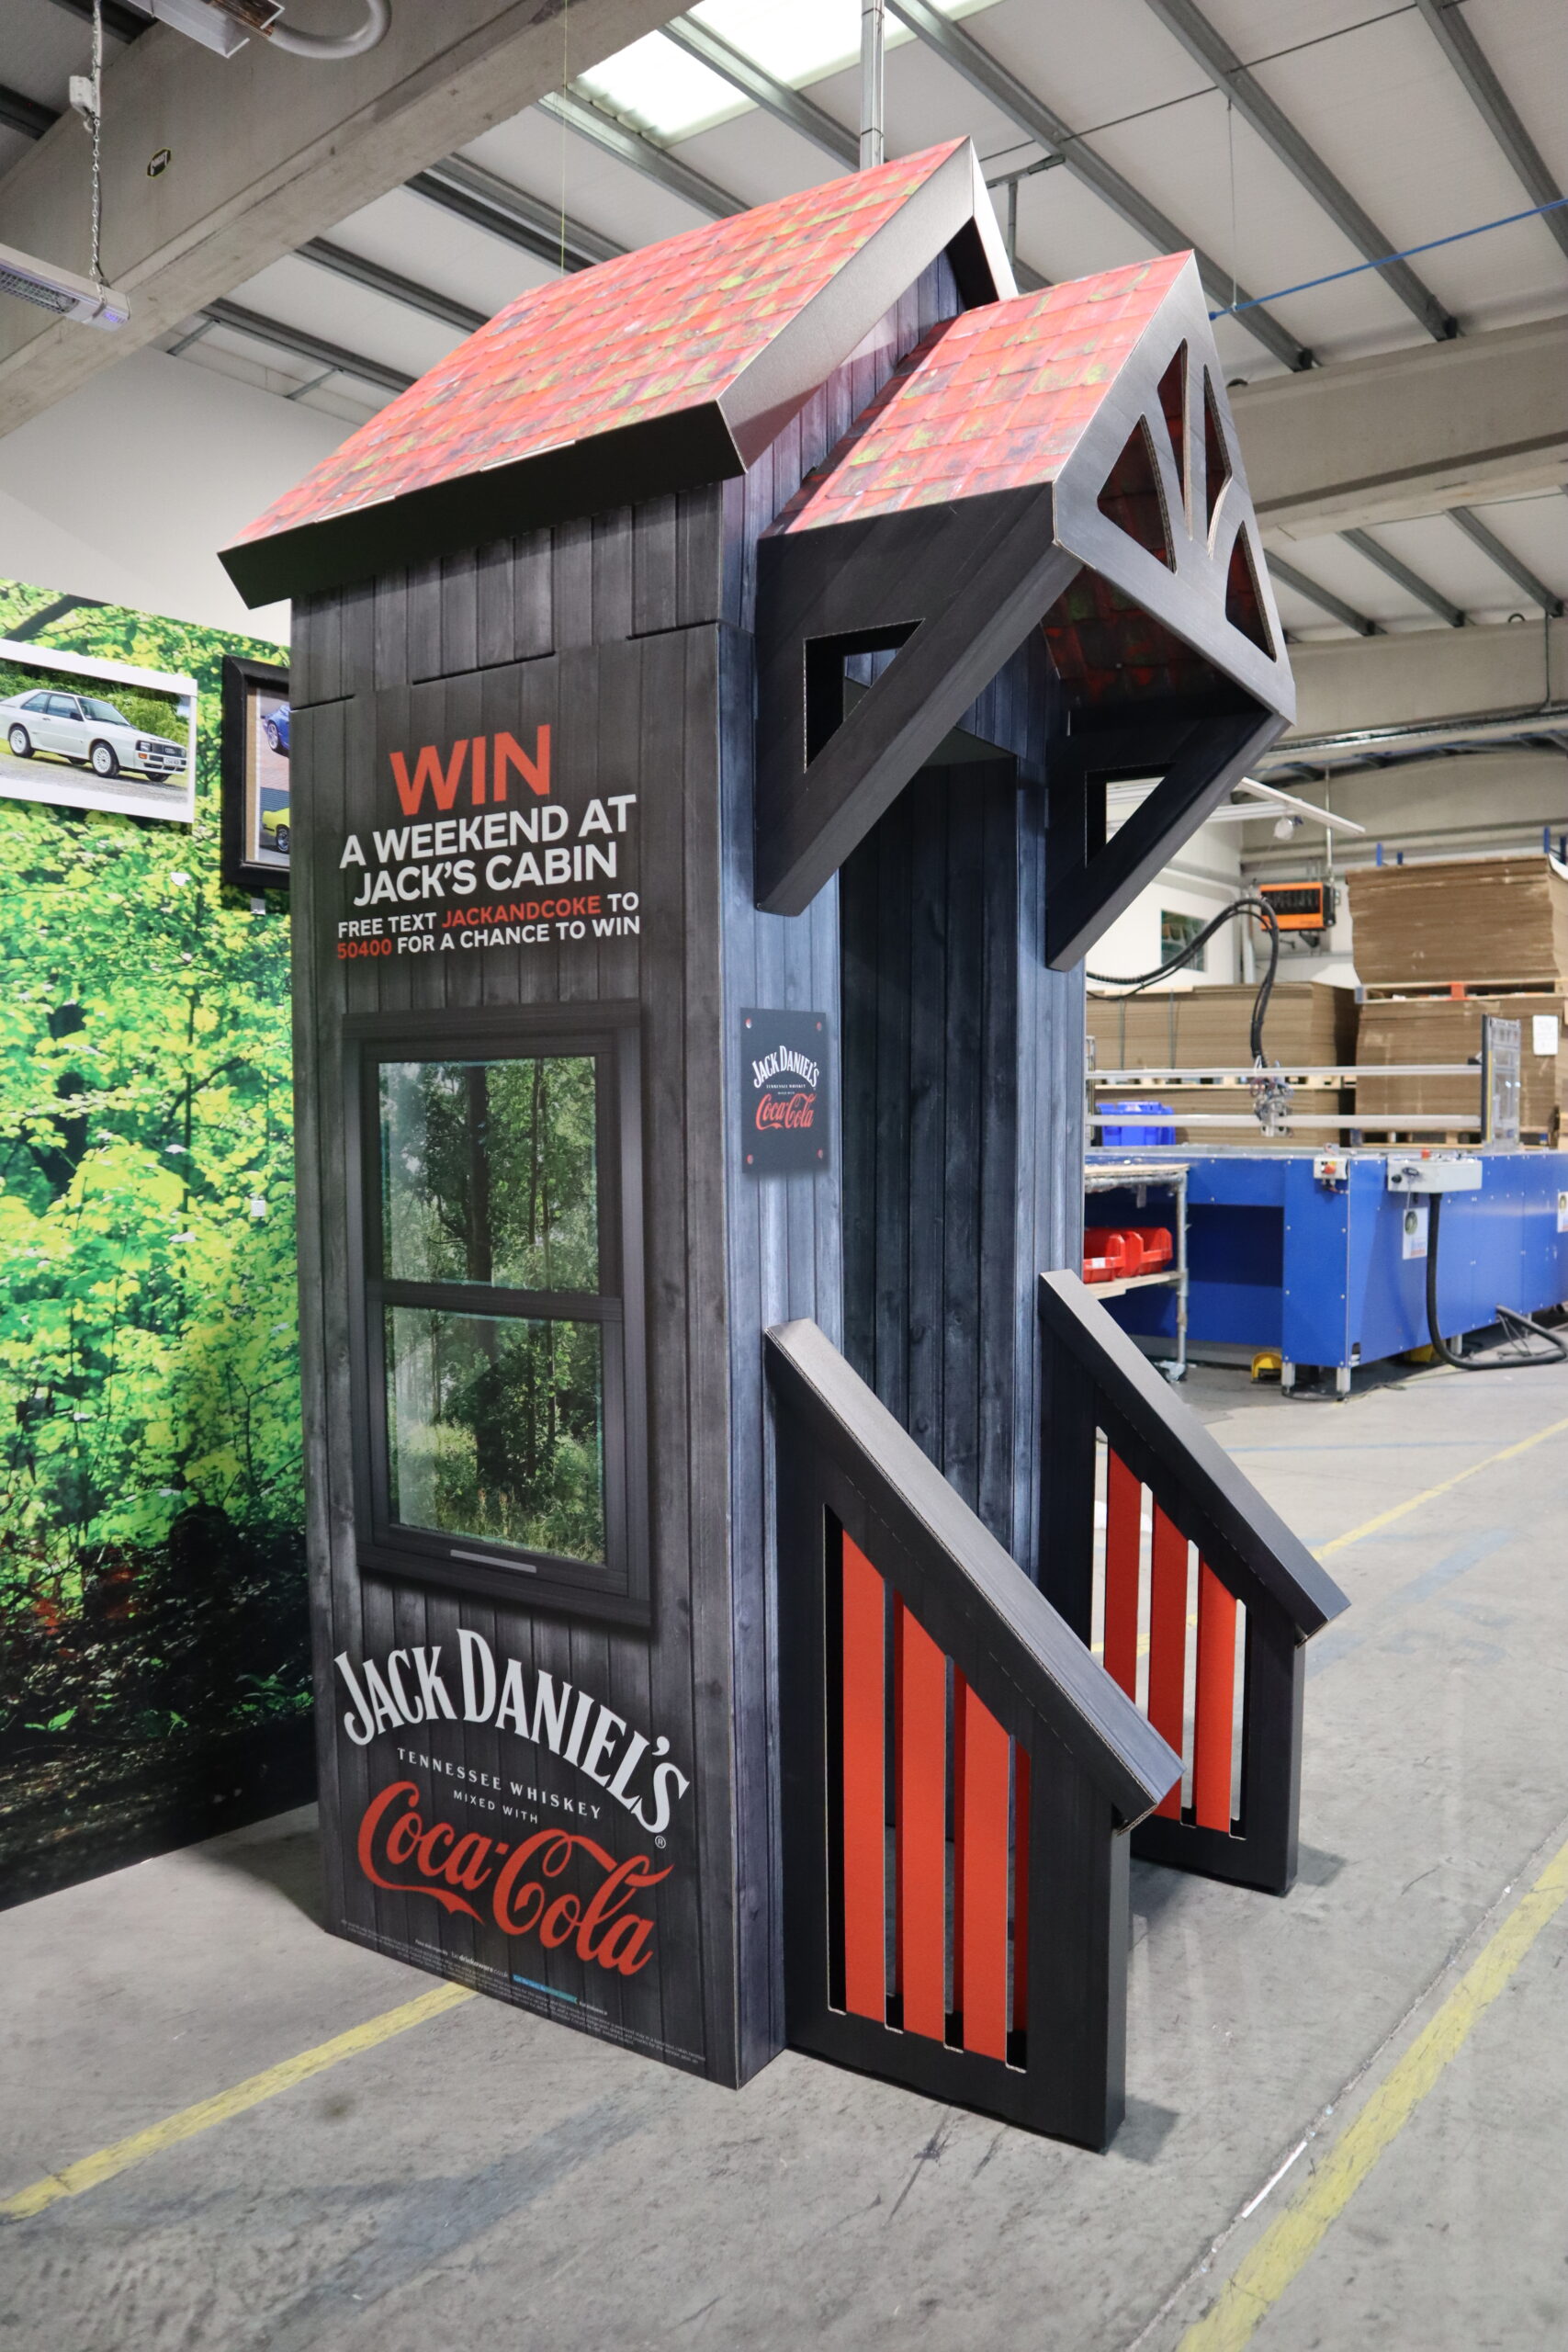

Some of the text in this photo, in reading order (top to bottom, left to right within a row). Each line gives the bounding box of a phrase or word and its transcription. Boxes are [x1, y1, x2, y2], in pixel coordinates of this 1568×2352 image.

[389, 725, 551, 816] WIN
[340, 794, 637, 868] A WEEKEND AT
[354, 842, 616, 906] JACK'S CABIN
[338, 916, 639, 958] 50400 FOR A CHANCE TO WIN
[339, 892, 638, 938] FREE TEXT JACKANDCOKE TO
[752, 1046, 819, 1088] JACK DANIEL'S
[334, 1629, 689, 1833] JACK DANIEL'S
[398, 1748, 600, 1818] TENNESSEE WHISKEY
[454, 1791, 537, 1823] MIXED WITH
[358, 1781, 672, 1975] Coca-Cola
